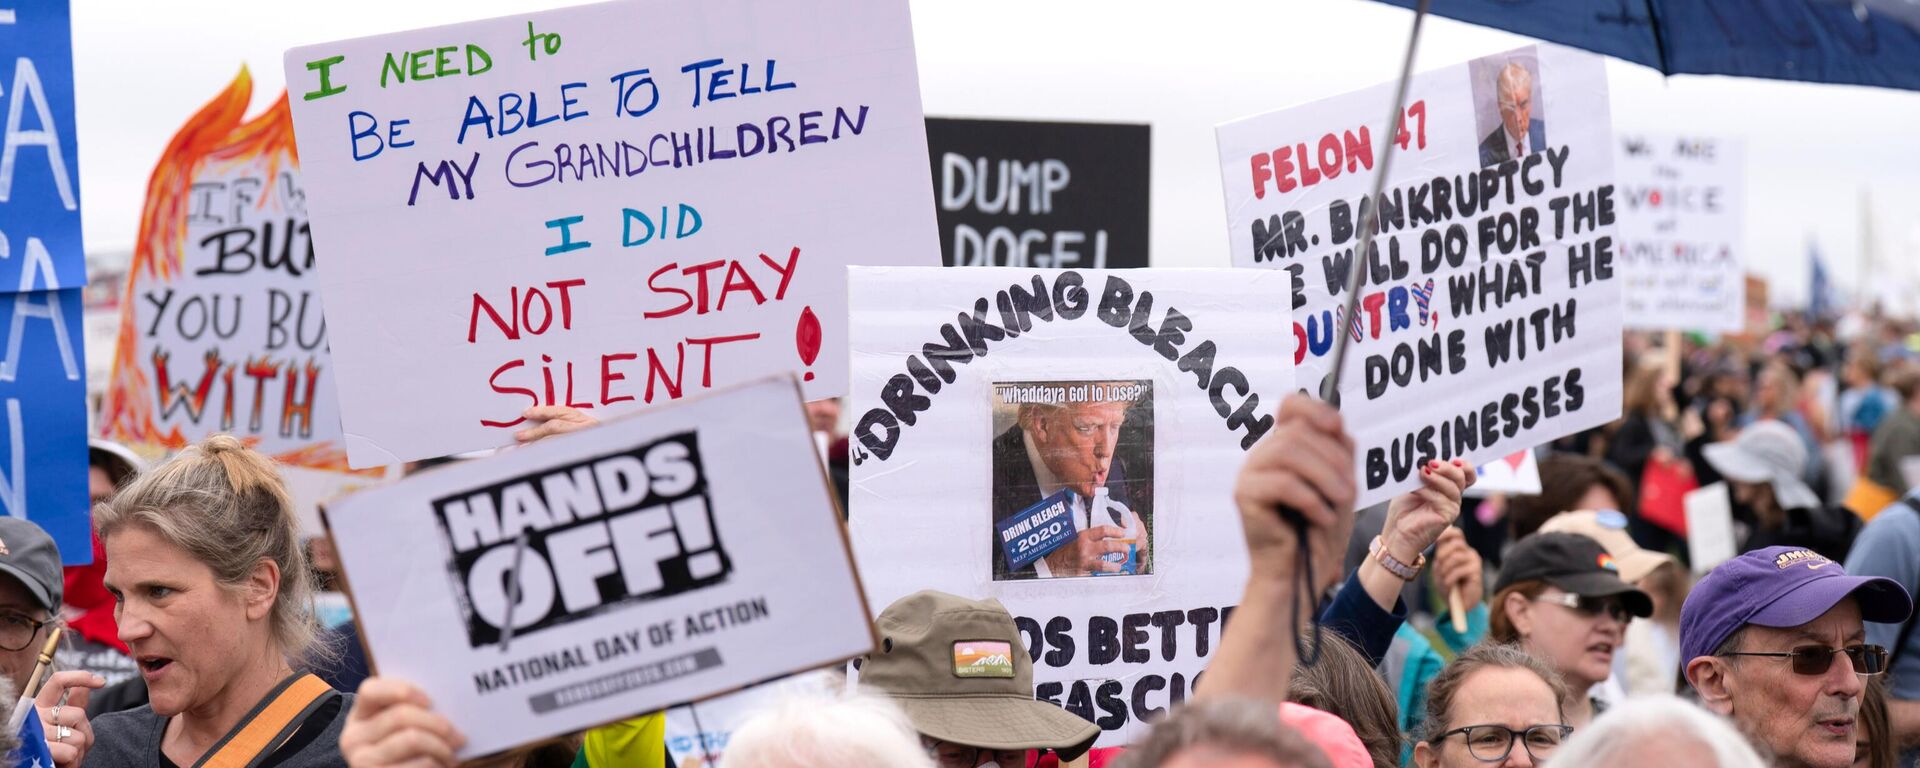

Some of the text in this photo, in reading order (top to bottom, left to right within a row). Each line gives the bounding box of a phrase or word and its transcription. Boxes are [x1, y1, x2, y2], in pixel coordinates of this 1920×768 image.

[304, 21, 562, 101] I NEED to
[0, 57, 77, 211] A
[348, 58, 797, 162] BE ABLE TO TELL
[408, 105, 870, 206] MY GRANDCHILDREN
[942, 151, 1072, 216] DUMP
[1250, 124, 1374, 200] FELON
[545, 203, 703, 256] I DID
[1251, 144, 1570, 264] MR. BANKRUPTCY
[1321, 233, 1411, 297] WILL
[1420, 223, 1470, 275] DO
[1477, 206, 1541, 264] FOR
[1547, 184, 1617, 241] THE
[1622, 185, 1724, 215] VOICE
[145, 288, 330, 352] YOU BU
[468, 246, 800, 343] NOT STAY
[1447, 251, 1548, 320] WHAT
[1567, 236, 1615, 289] HE
[150, 346, 321, 439] WITH
[1096, 274, 1276, 452] BLEACH
[1365, 329, 1468, 401] DONE
[1485, 297, 1578, 369] WITH
[1068, 384, 1088, 404] Got
[1091, 383, 1103, 403] to
[1365, 367, 1586, 492] BUSINESSES
[443, 441, 698, 553] HANDS
[1002, 500, 1066, 543] DRINK BLEACH
[1017, 521, 1062, 553] 2020
[466, 496, 724, 630] OFF!
[1028, 539, 1053, 556] AMERICA
[473, 648, 591, 695] NATIONAL
[593, 630, 641, 663] DAY
[648, 619, 678, 648] OF
[684, 596, 770, 639] ACTION
[1088, 606, 1239, 666] BETT
[1036, 672, 1206, 731] FASCI
